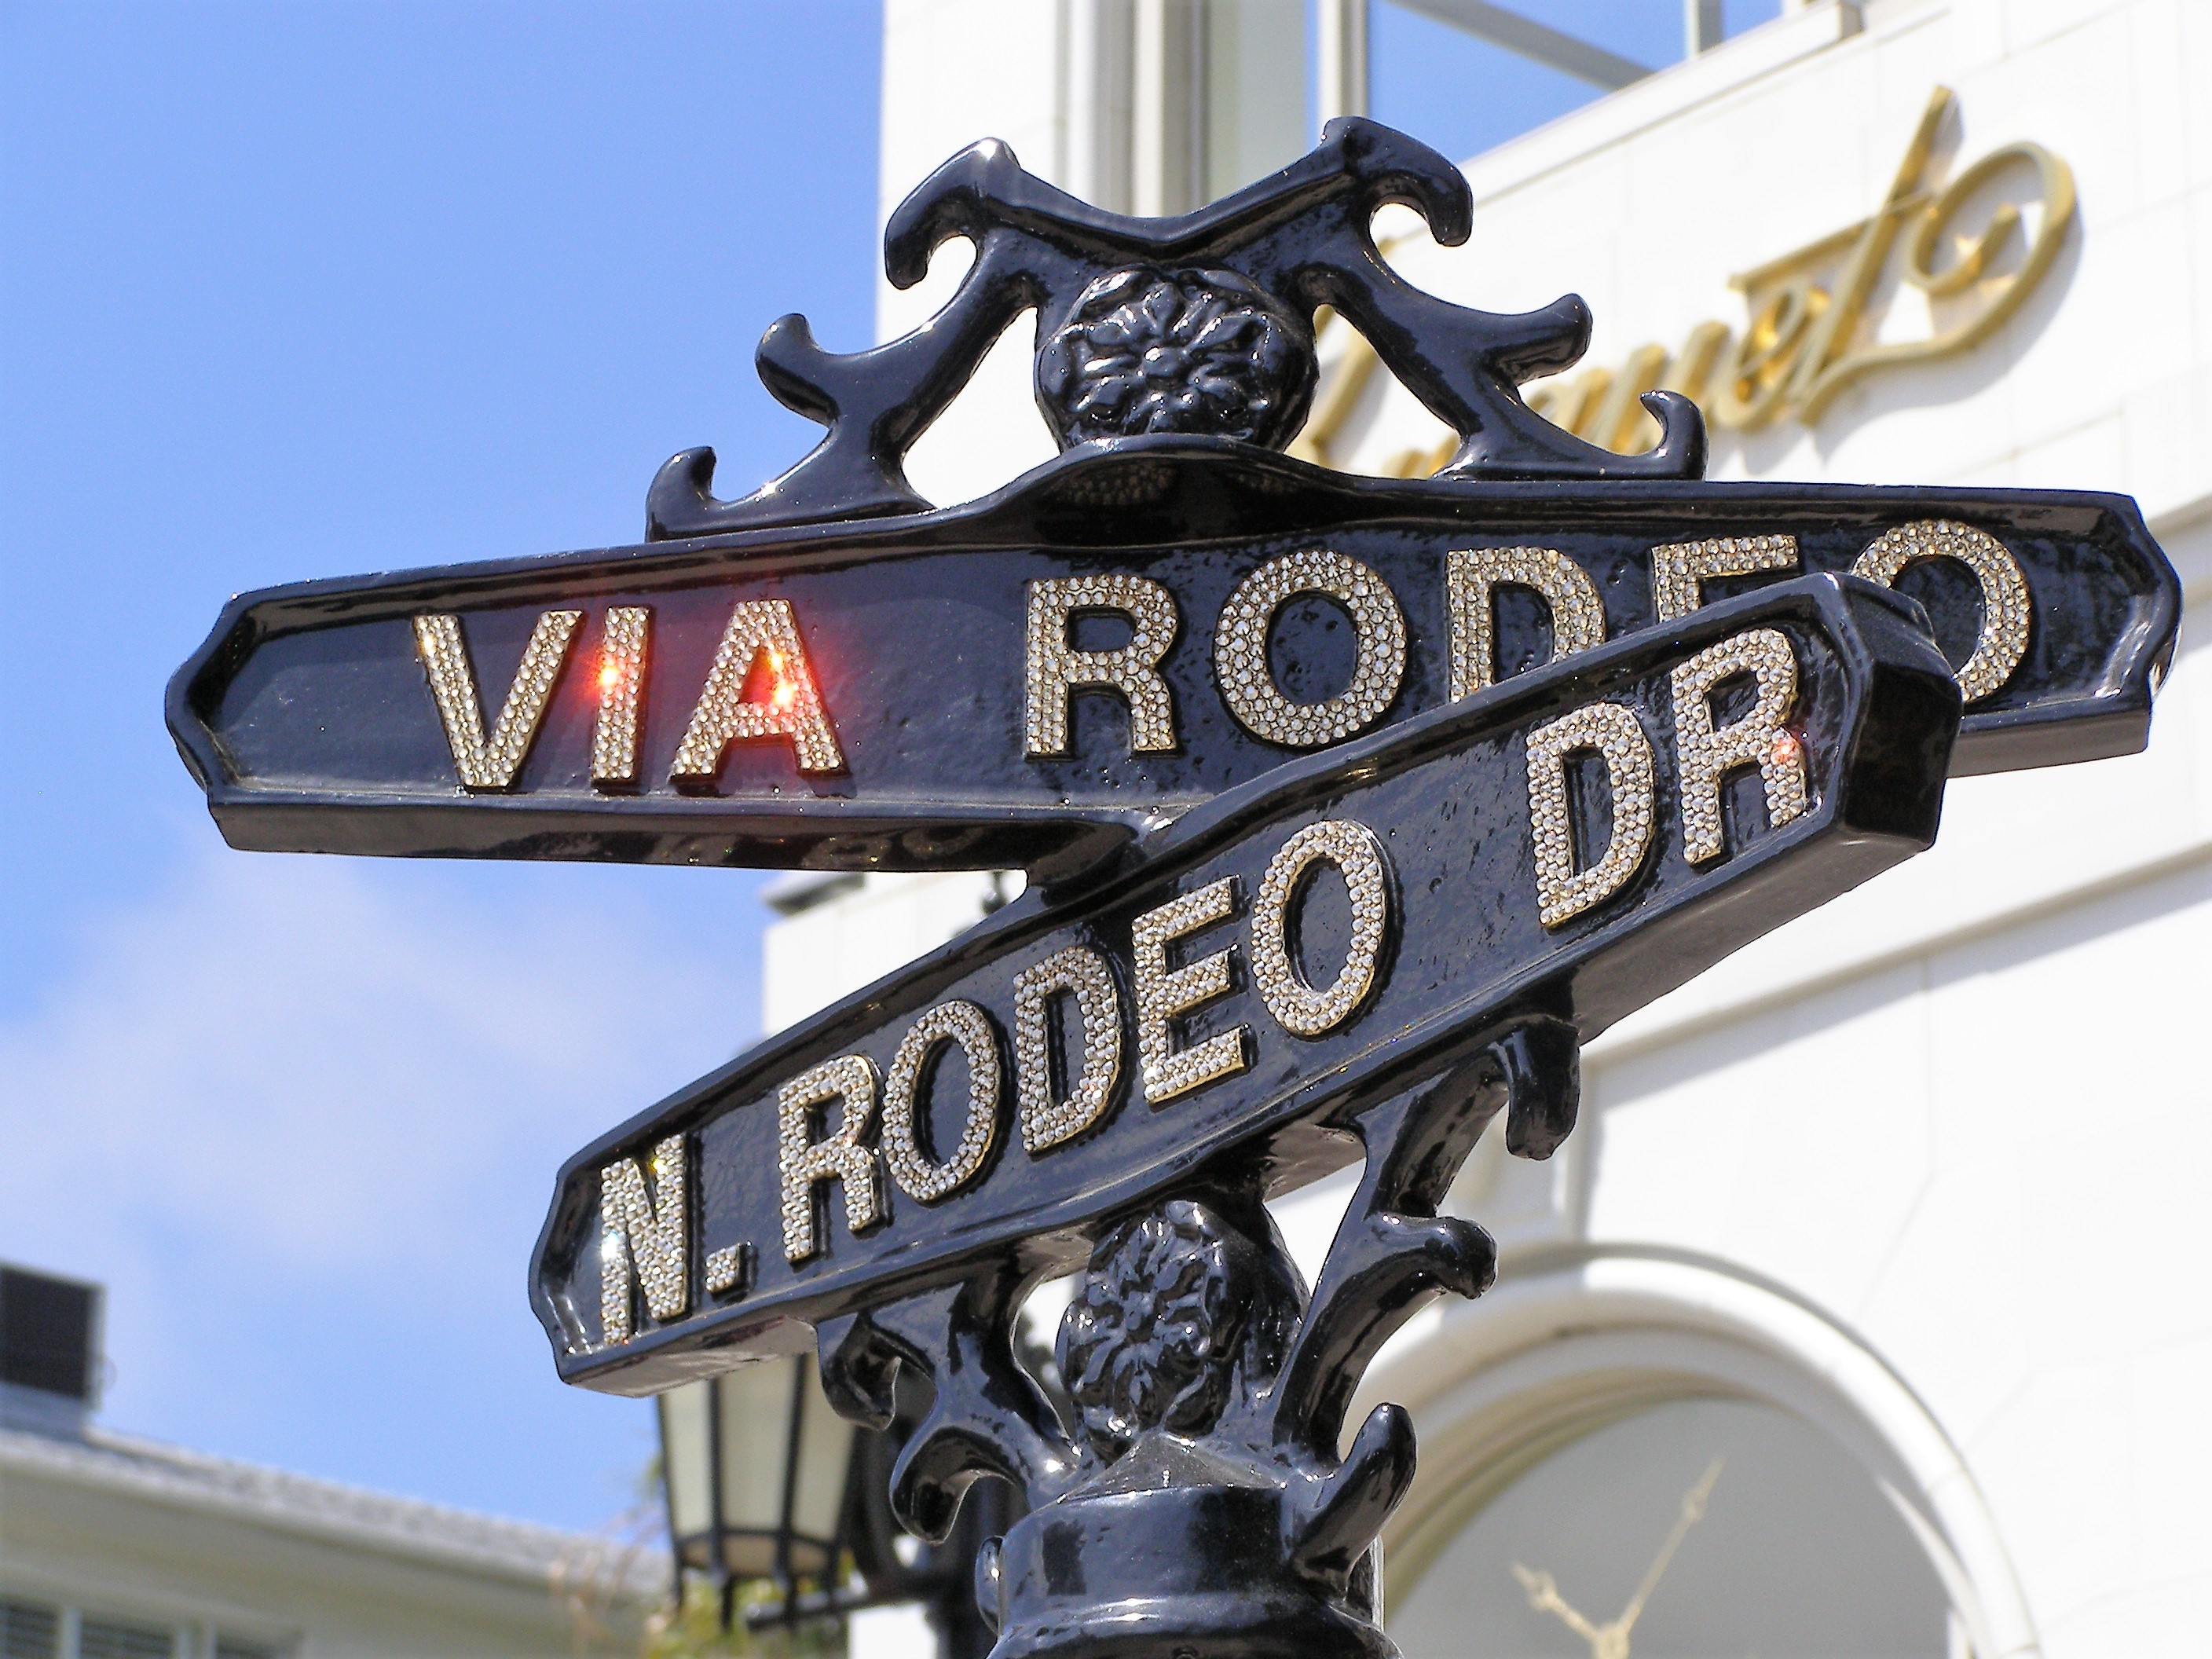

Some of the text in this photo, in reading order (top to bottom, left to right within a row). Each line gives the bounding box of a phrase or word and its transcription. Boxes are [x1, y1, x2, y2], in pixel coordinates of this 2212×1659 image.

[412, 599, 844, 790] VIA
[596, 628, 1808, 1344] N. RODEO DR
